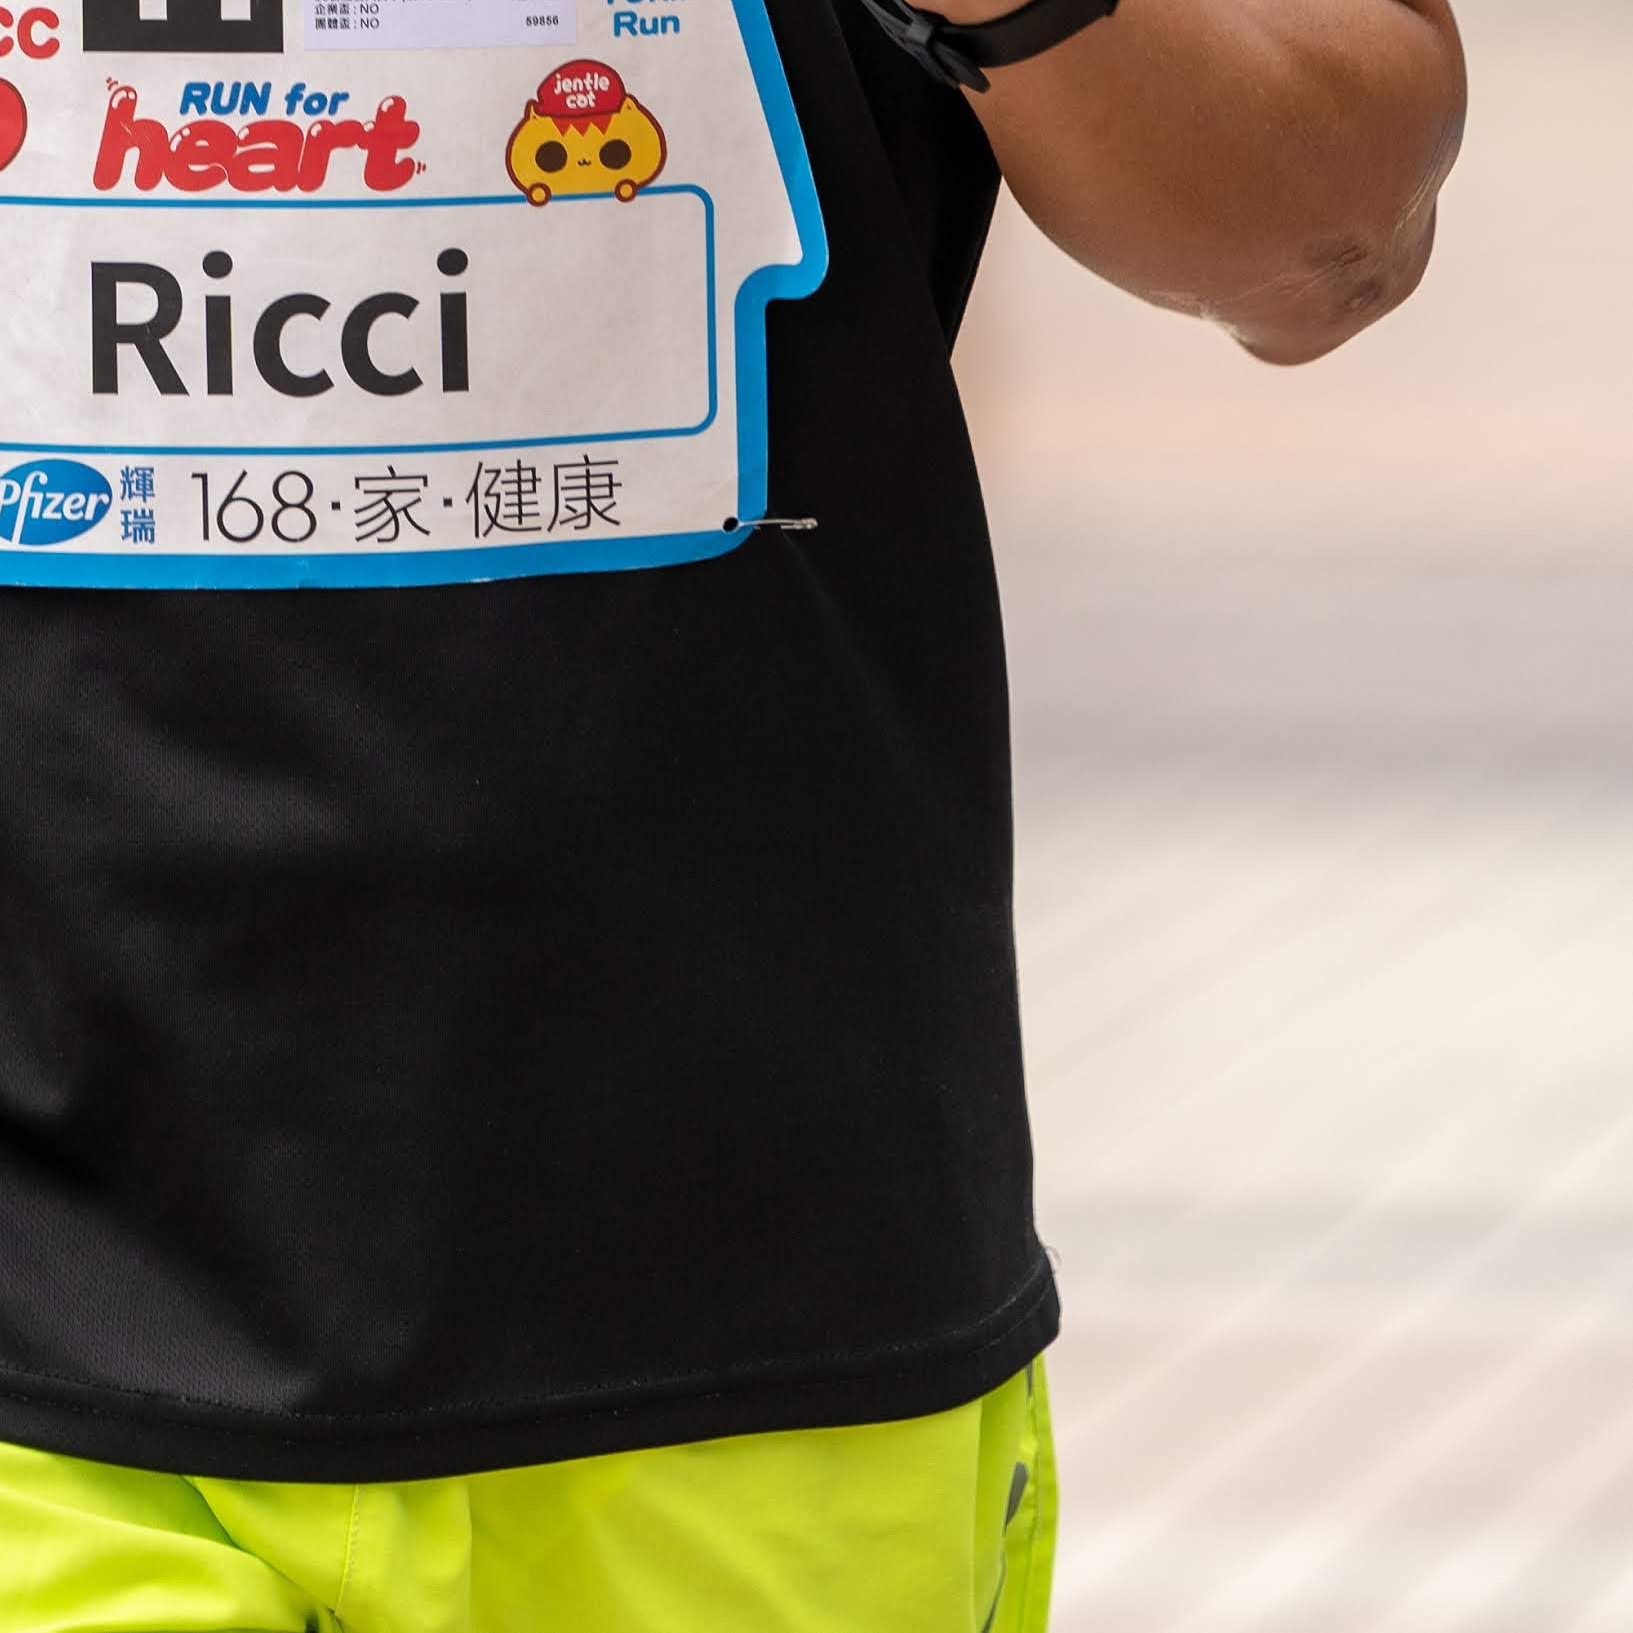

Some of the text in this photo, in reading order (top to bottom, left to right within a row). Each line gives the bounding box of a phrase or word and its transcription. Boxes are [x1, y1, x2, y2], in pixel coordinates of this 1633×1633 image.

[360, 3, 380, 15] NO
[360, 17, 380, 30] NO
[613, 11, 681, 37] Run
[179, 81, 350, 116] RUN for
[554, 73, 610, 95] jentle
[93, 85, 421, 193] heart
[91, 248, 470, 397] Ricci
[120, 465, 156, 545] 輝瑞
